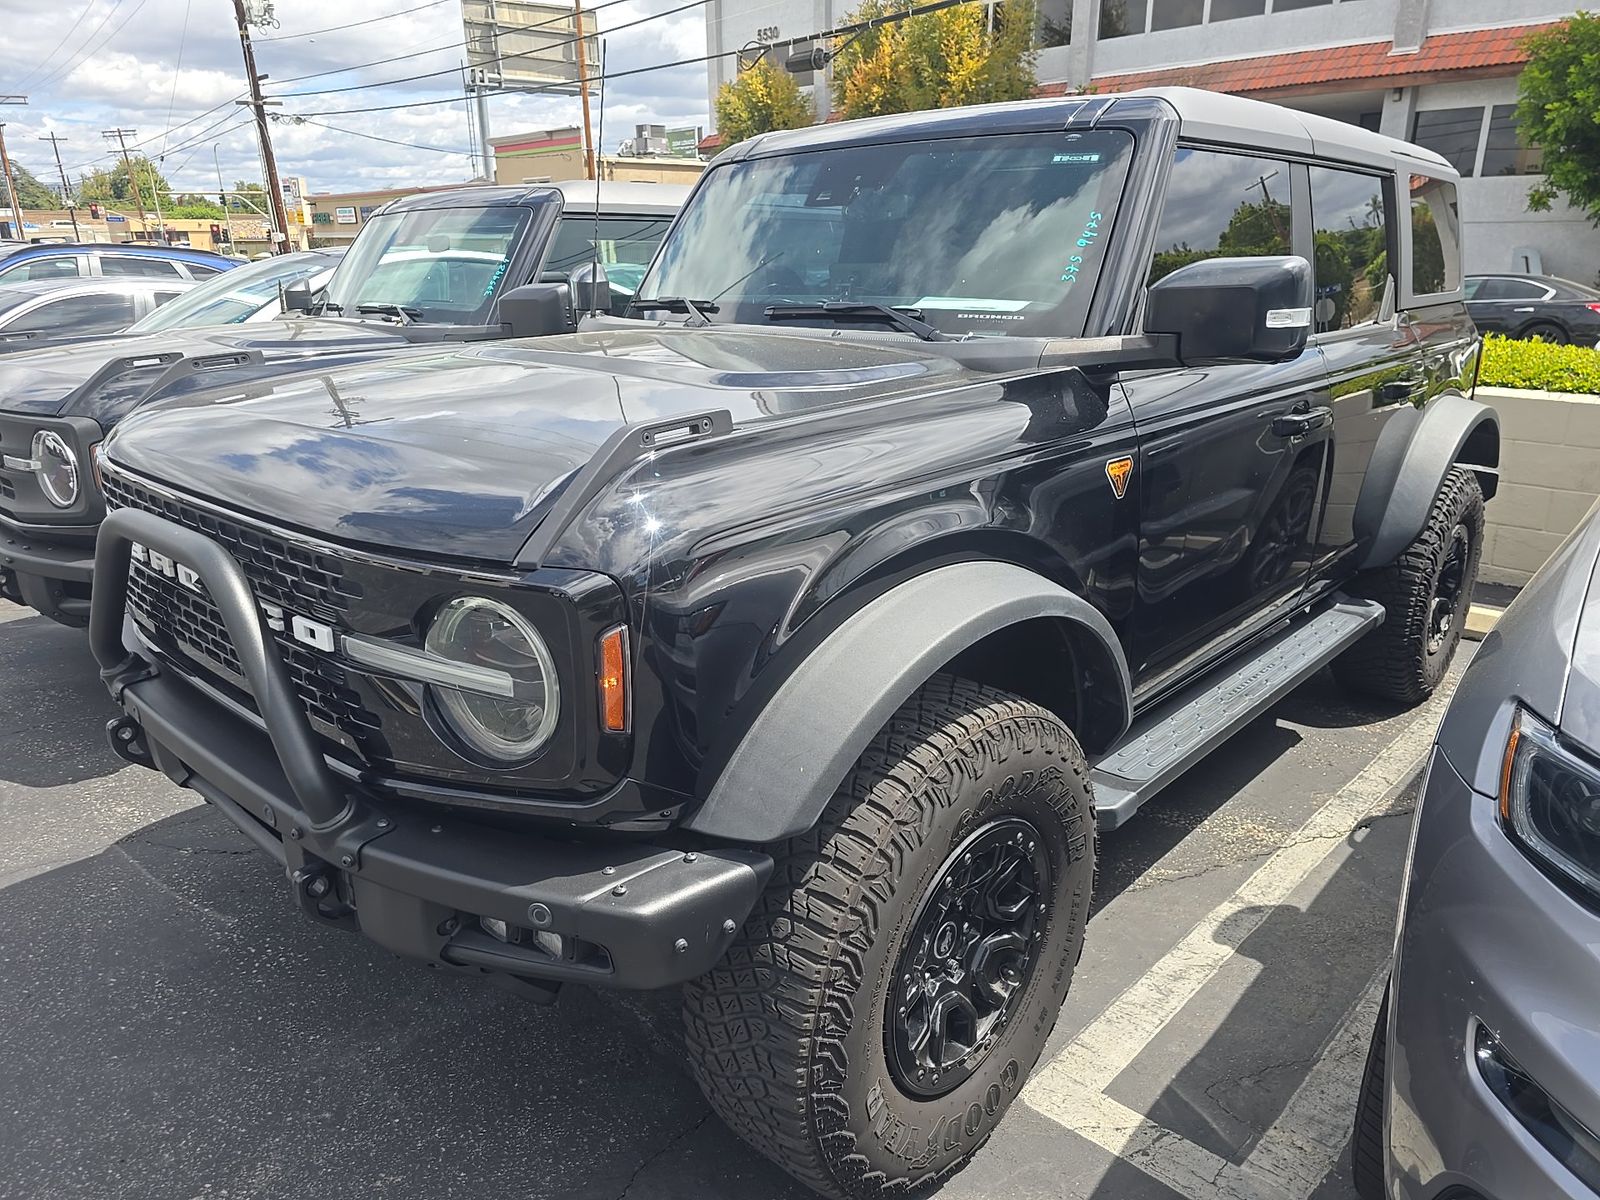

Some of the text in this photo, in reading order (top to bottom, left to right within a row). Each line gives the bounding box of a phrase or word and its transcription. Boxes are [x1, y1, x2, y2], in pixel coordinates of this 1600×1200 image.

[758, 26, 779, 41] 5530
[1061, 211, 1102, 283] 375 9475
[131, 541, 335, 653] BROCO
[865, 1056, 1020, 1171] GOODYEAR
